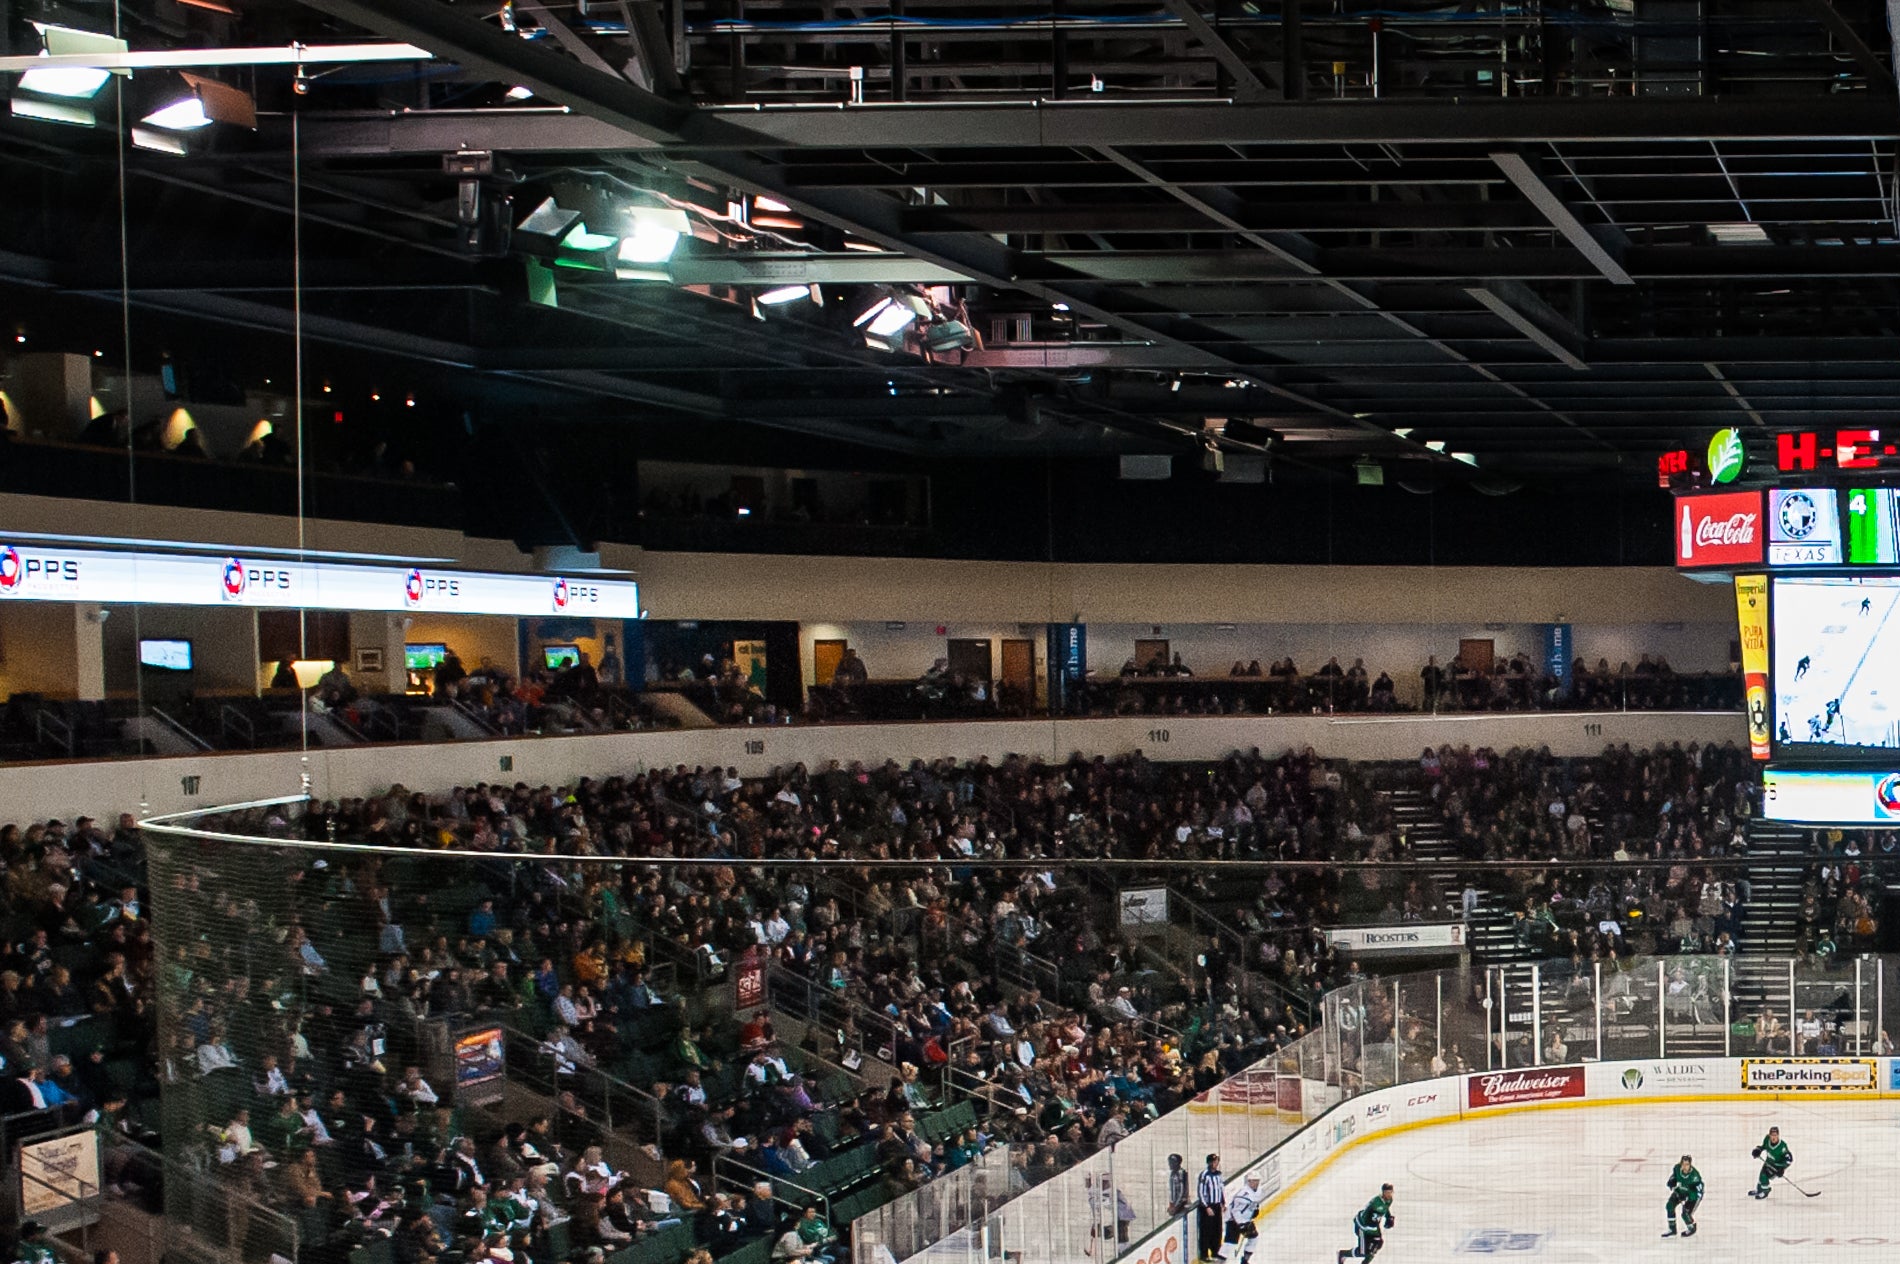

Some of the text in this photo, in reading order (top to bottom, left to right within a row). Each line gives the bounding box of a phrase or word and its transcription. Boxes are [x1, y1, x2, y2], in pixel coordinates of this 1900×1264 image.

[1849, 494, 1867, 515] 4
[1776, 547, 1827, 562] TEXAS
[26, 558, 78, 581] PPS
[249, 569, 290, 590] PPS
[425, 579, 460, 597] PPS
[570, 586, 599, 603] PPS
[1744, 626, 1764, 638] PURA
[1744, 638, 1765, 650] VIDA
[1148, 729, 1170, 743] 110
[1583, 724, 1601, 736] 111
[1365, 931, 1420, 945] ROOSTERS
[1653, 1064, 1705, 1075] WALDEN
[1481, 1072, 1570, 1097] Budweiser
[1408, 1094, 1438, 1107] CCM
